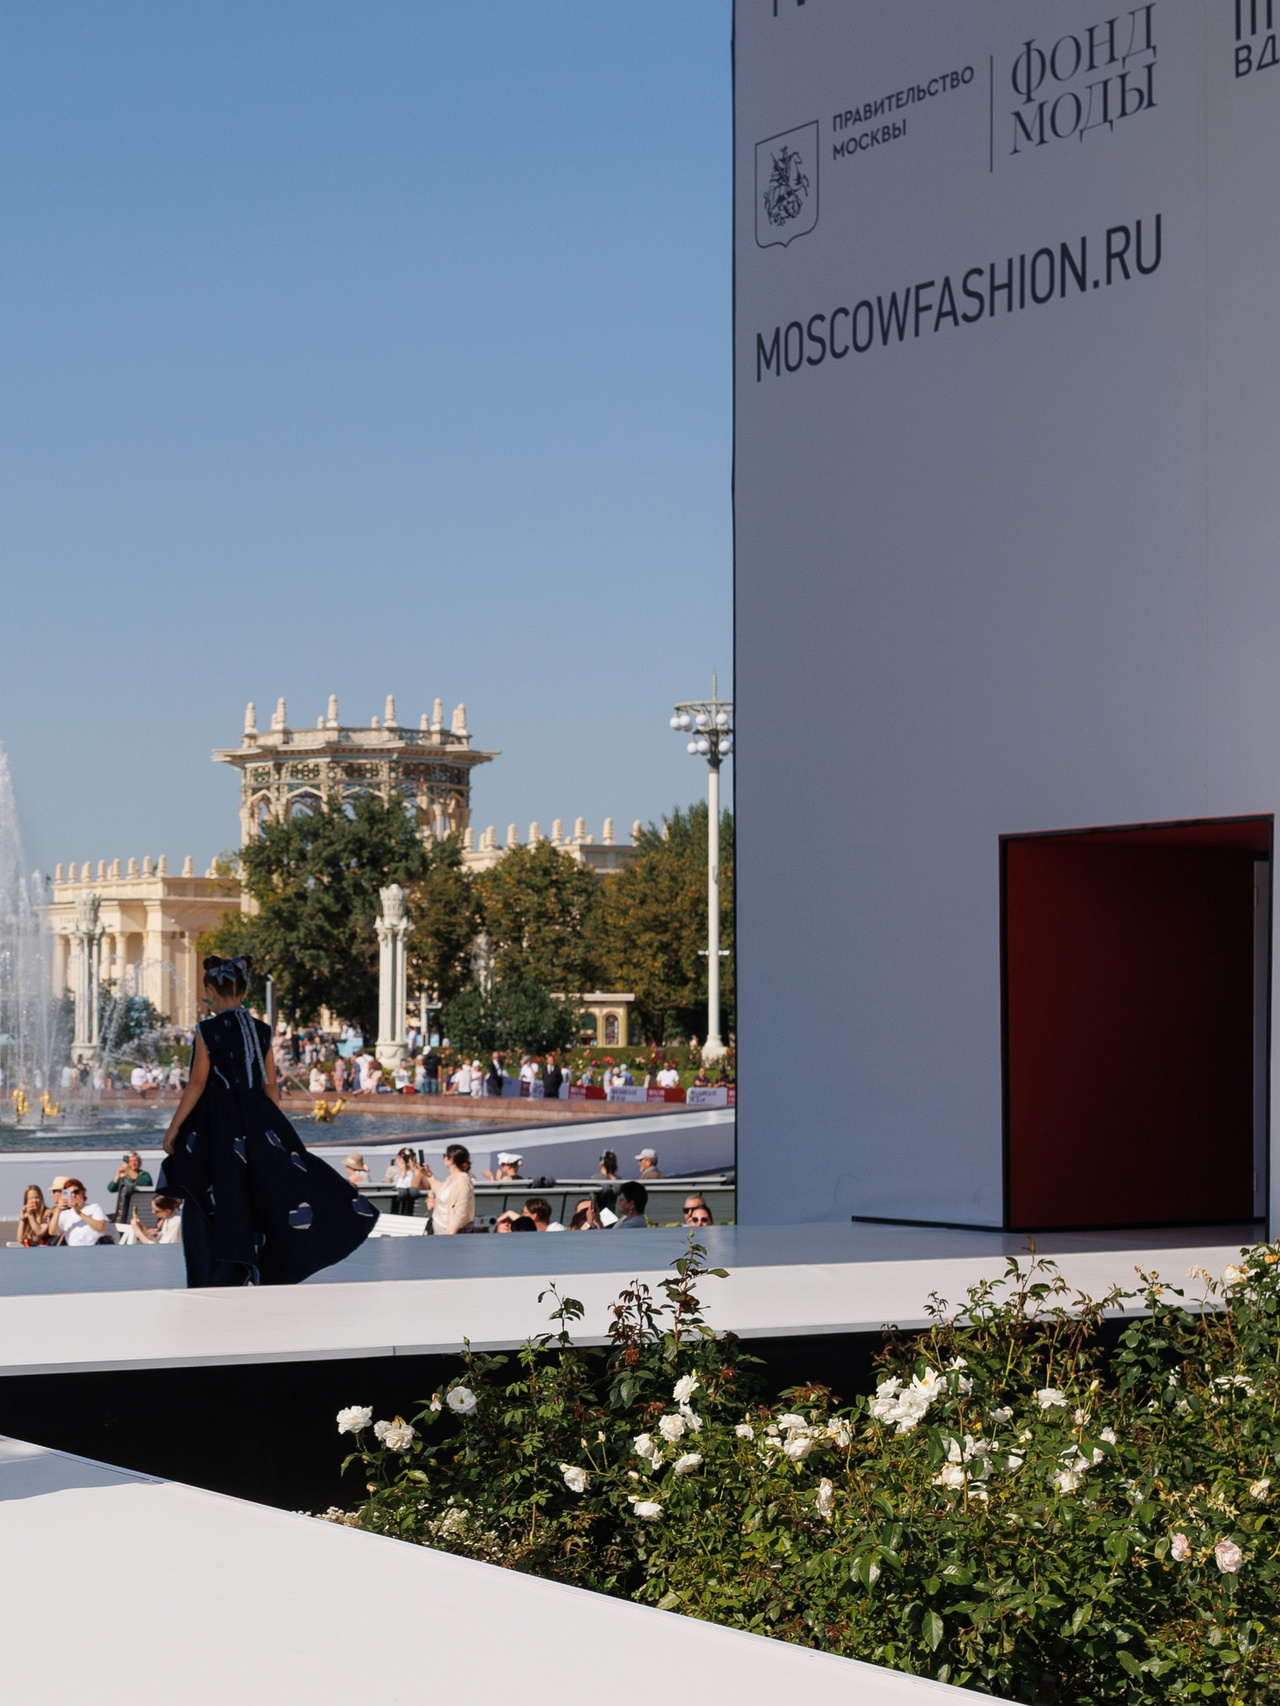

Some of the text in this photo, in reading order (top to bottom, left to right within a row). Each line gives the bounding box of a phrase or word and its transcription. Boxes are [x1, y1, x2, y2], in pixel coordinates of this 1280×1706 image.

[832, 65, 975, 132] ПРАВИТЕЛЬСТВО
[1011, 2, 1157, 105] ФОНД
[832, 118, 907, 160] МОСКВЫ
[1010, 61, 1158, 155] МОДЫ
[756, 213, 1162, 383] MOSCOWFASHION.RU
